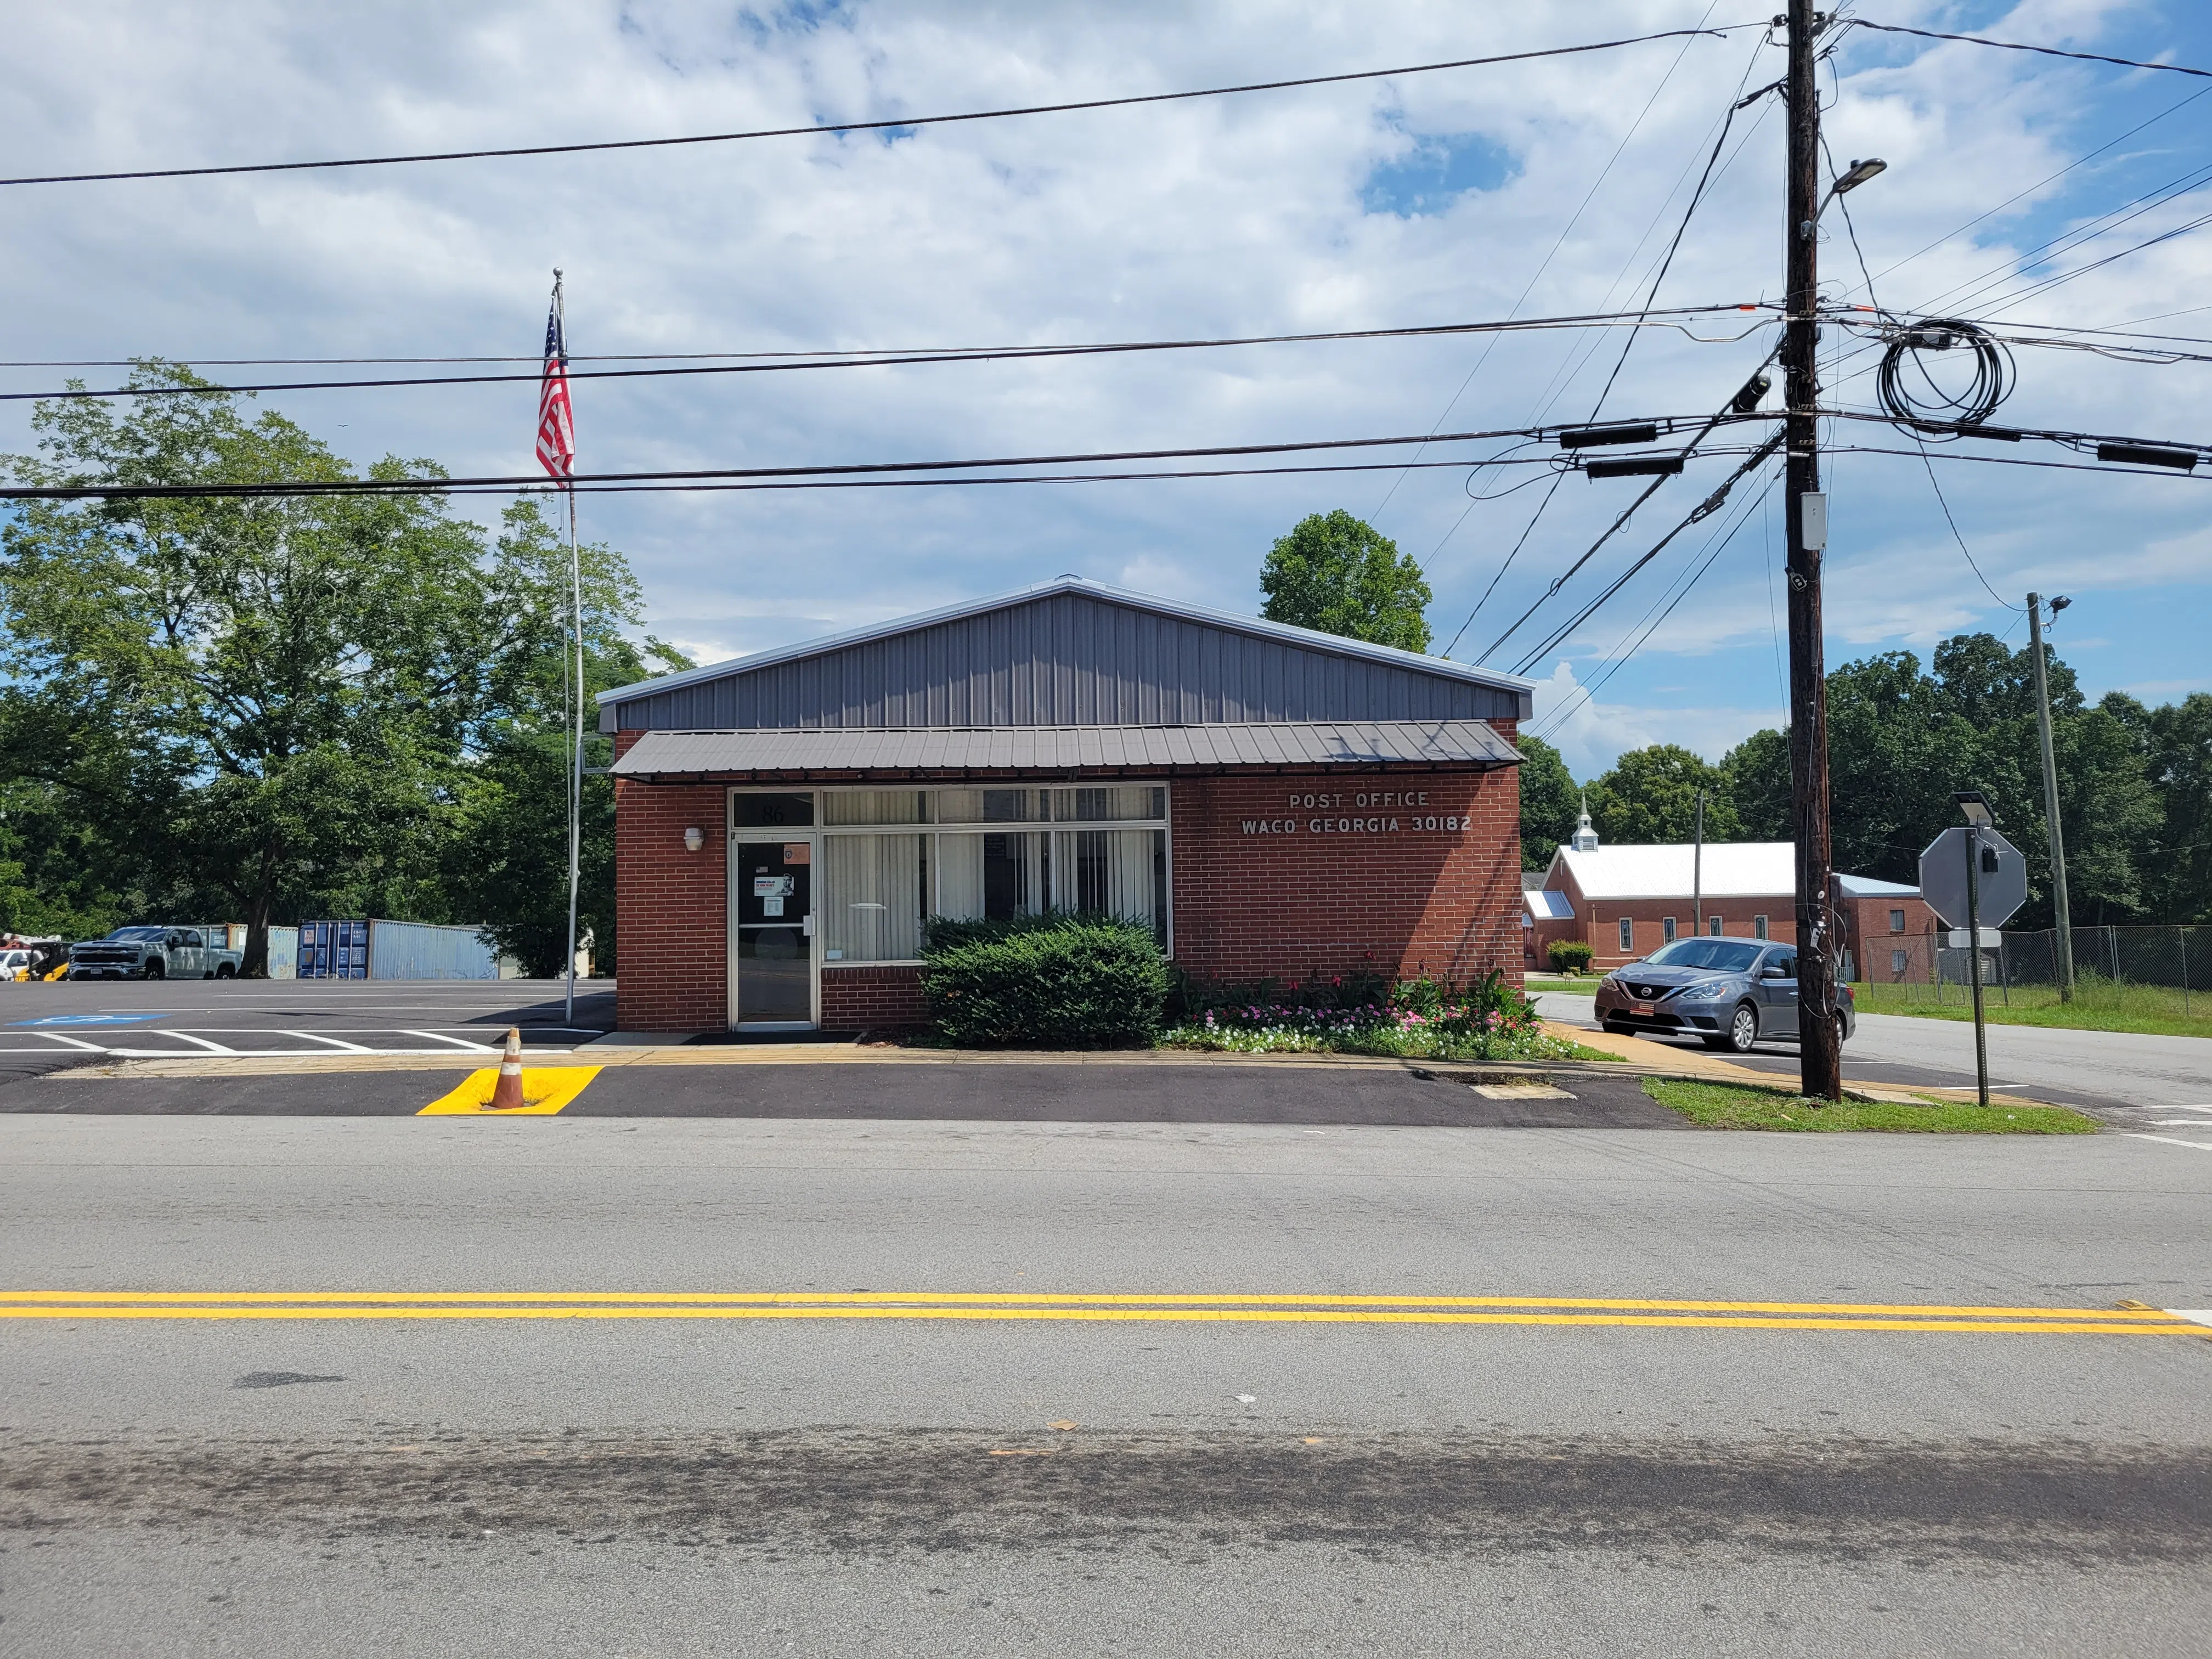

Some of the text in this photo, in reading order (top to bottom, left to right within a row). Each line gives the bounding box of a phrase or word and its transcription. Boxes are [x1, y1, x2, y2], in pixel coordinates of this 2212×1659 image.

[1290, 792, 1429, 809] POST OFFICE
[763, 805, 783, 823] 86
[1242, 816, 1471, 834] WACO GEORGIA 30182
